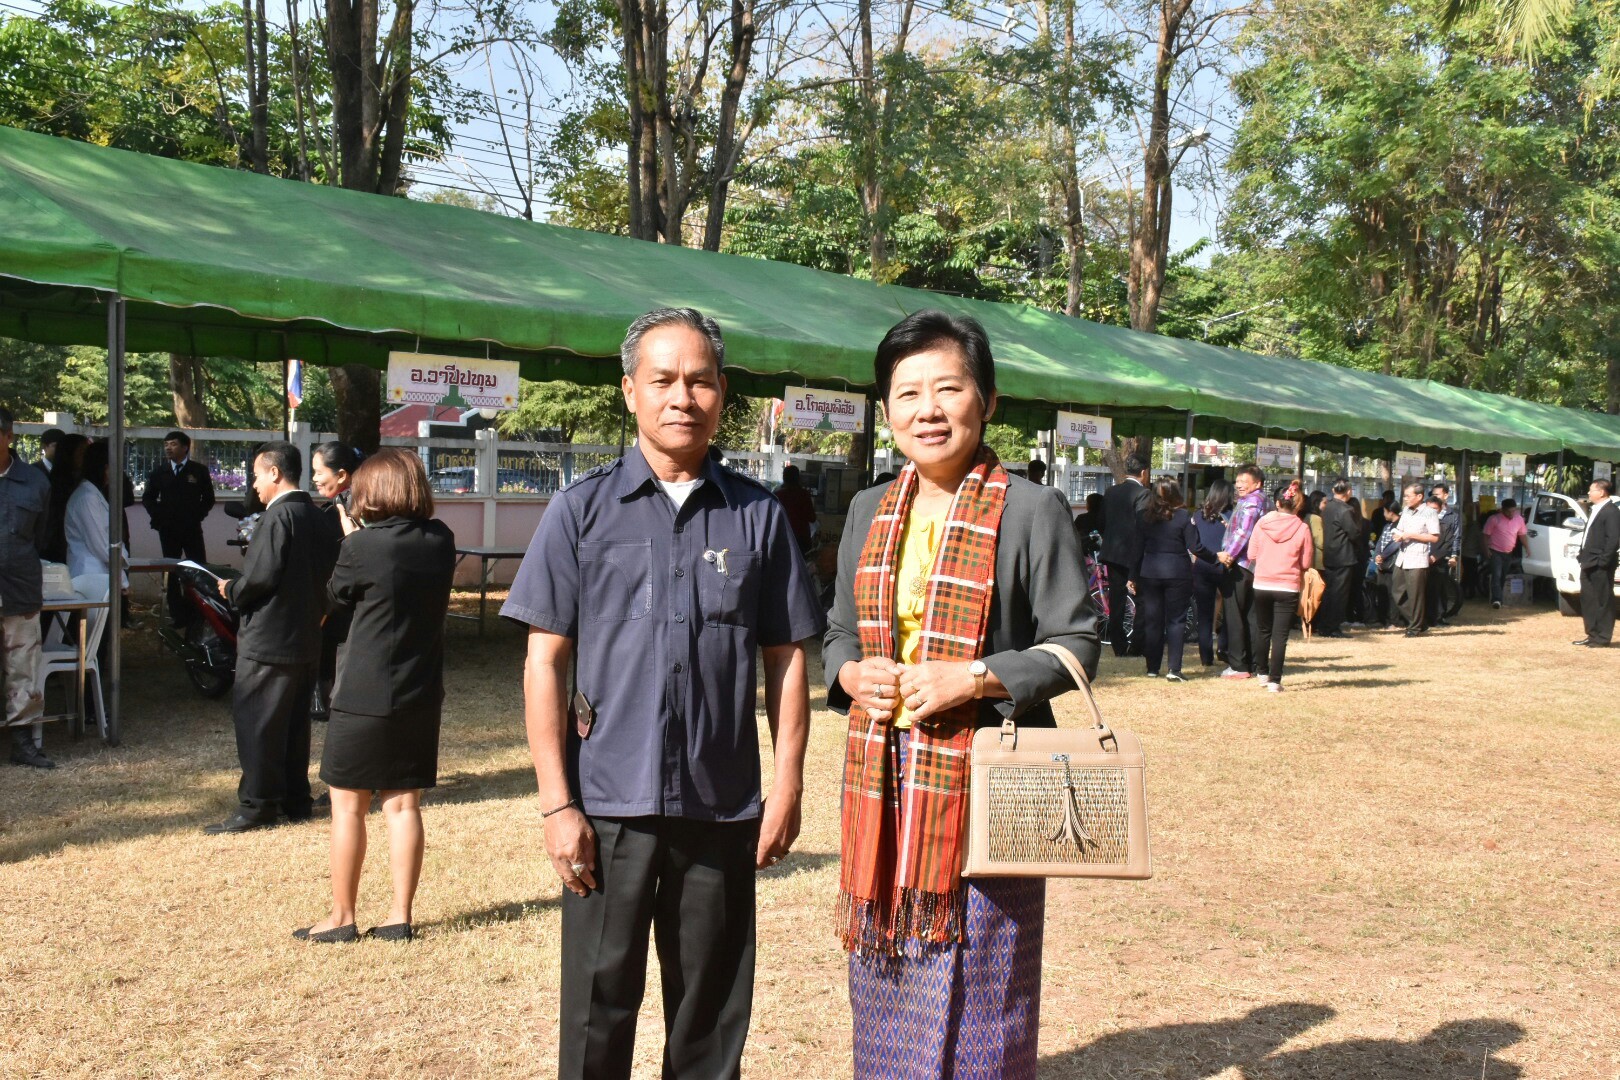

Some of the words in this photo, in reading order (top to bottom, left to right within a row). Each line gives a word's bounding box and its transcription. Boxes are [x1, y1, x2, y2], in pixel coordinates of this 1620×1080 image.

[410, 364, 497, 393] อ.วาปีปทุม
[795, 393, 855, 417] อ.โกสุมพิสัย
